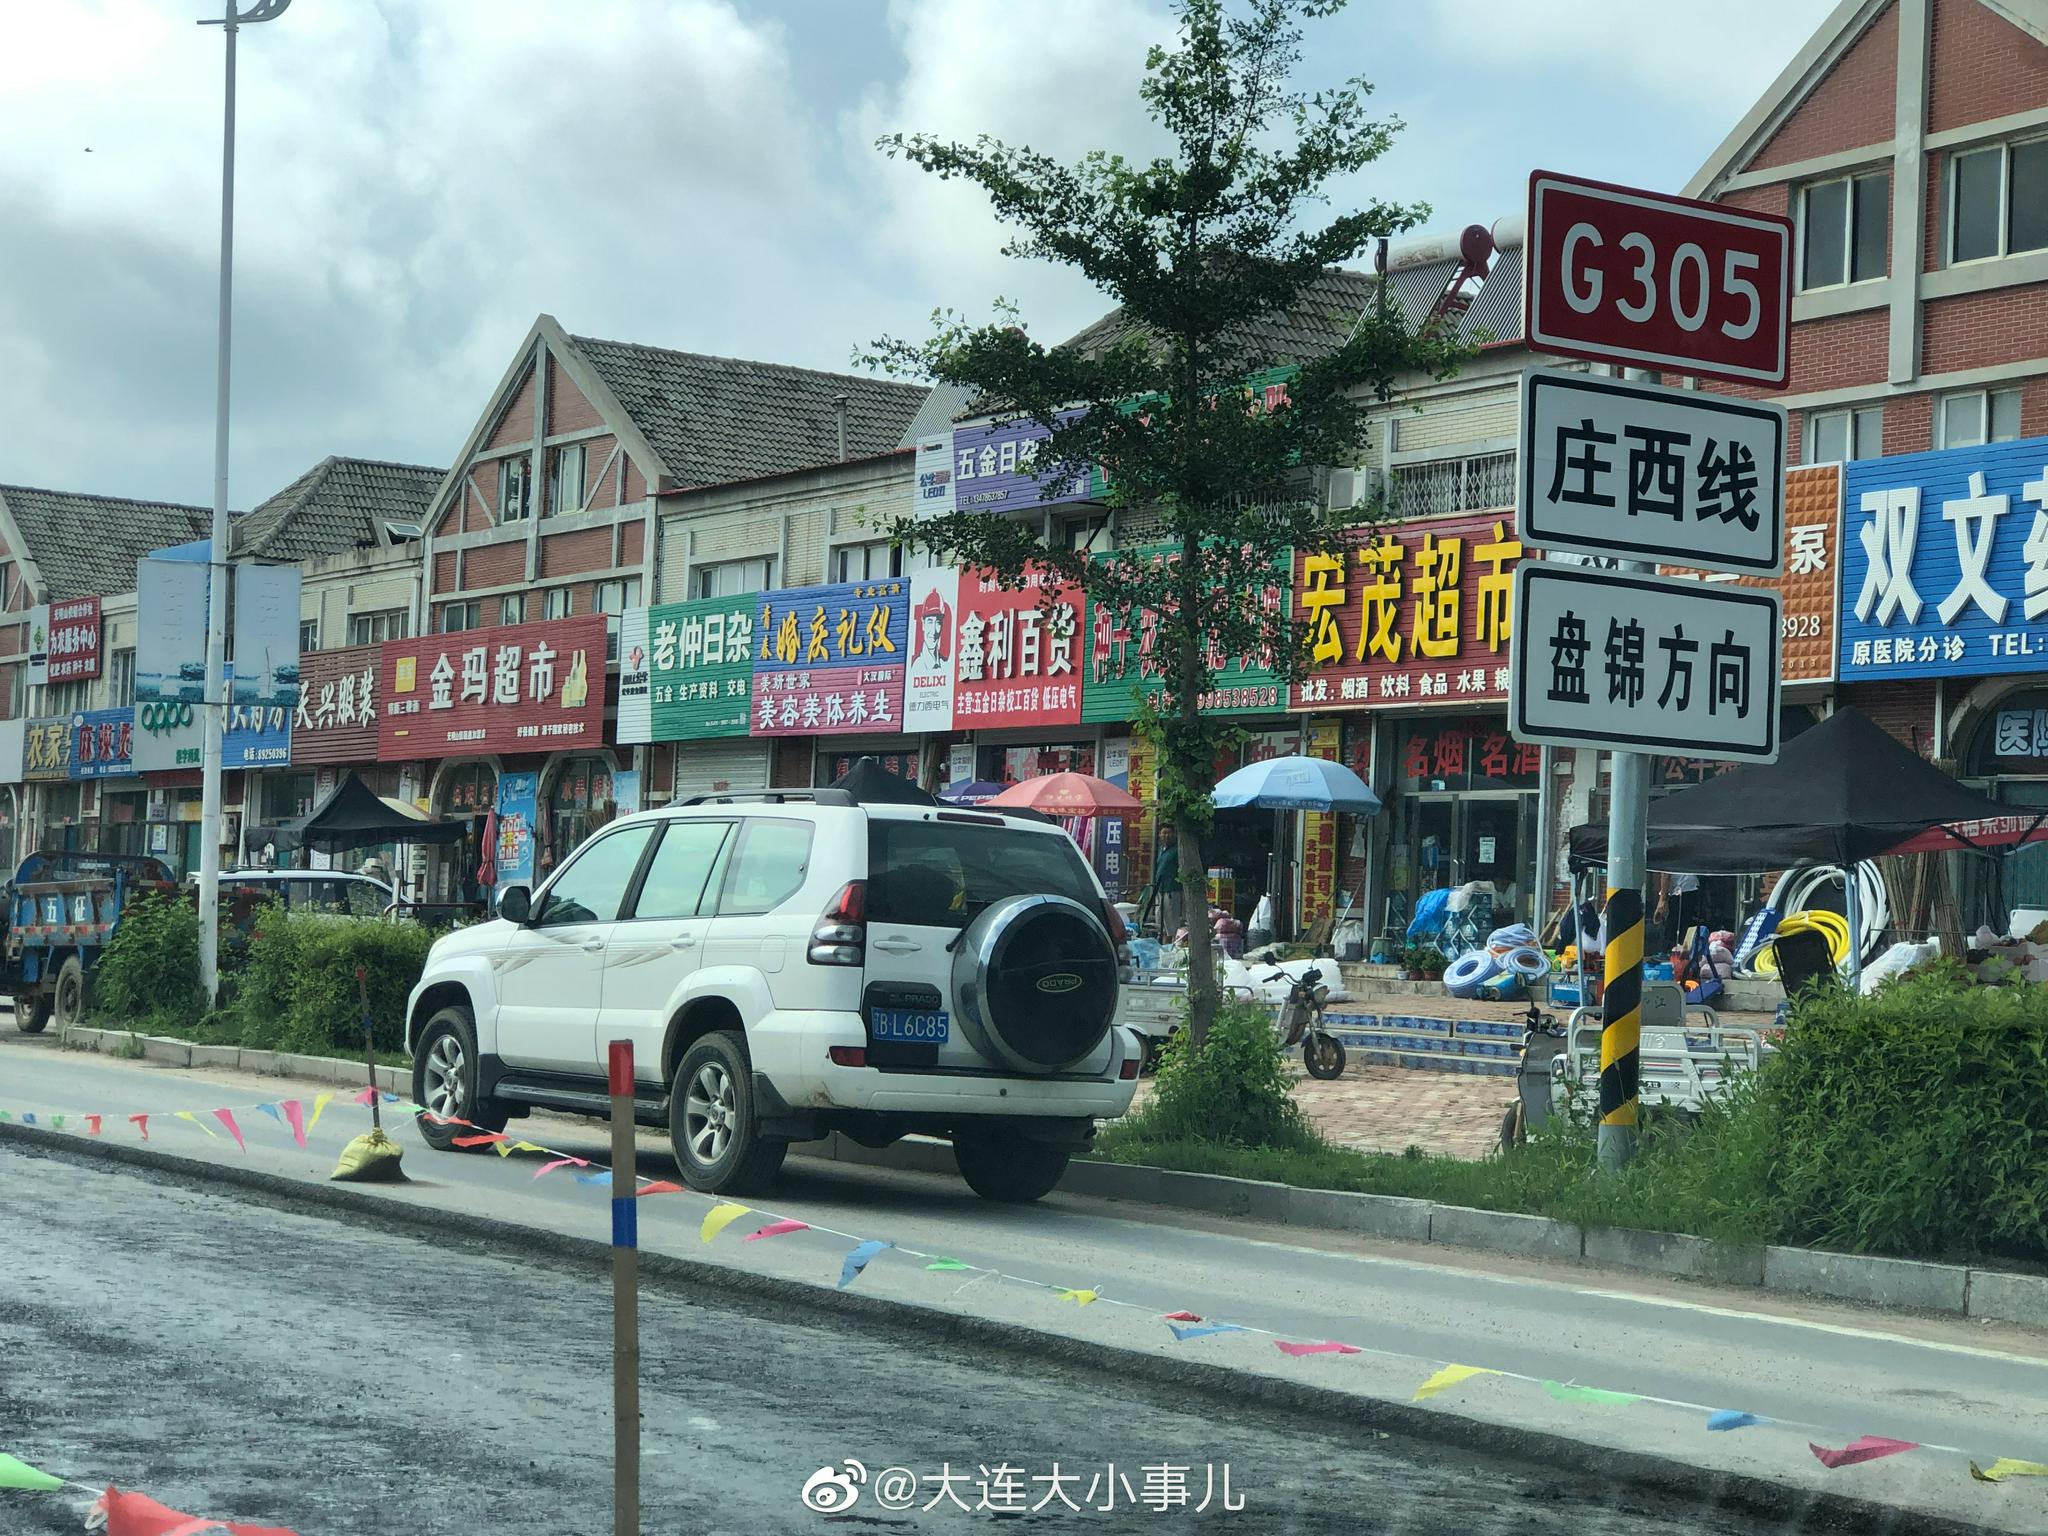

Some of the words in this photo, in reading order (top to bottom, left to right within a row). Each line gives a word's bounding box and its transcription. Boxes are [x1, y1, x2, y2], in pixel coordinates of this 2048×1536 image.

[1561, 222, 1762, 340] G305
[1547, 418, 1760, 532] 庄西线
[1789, 523, 1828, 575] 泵
[1301, 520, 1522, 664] 宏茂超市
[653, 610, 753, 670] 老仲日杂
[776, 603, 896, 664] 婚庆礼仪
[958, 602, 1076, 682] 鑫利百货
[1851, 634, 1966, 665] 原医院分诊
[1989, 632, 2044, 657] TEL:
[429, 640, 558, 710] 金玛超市
[913, 675, 946, 689] DELIXI
[1341, 677, 1369, 700] 烟酒
[1380, 673, 1410, 697] 饮料
[1419, 672, 1448, 697] 食品
[1457, 669, 1486, 694] 水果
[1547, 610, 1751, 719] 盘锦方向
[655, 685, 673, 703] 五金
[679, 681, 719, 701] 生产资料
[727, 678, 746, 697] 交电
[758, 689, 893, 729] 美容美体养生
[909, 700, 949, 711] 德力西电气
[1042, 684, 1076, 710] 低压电气
[1186, 686, 1278, 709] 998538528
[79, 721, 132, 762] 麻辣烫
[1405, 730, 1465, 778] 名烟
[1481, 735, 1540, 777] 名酒
